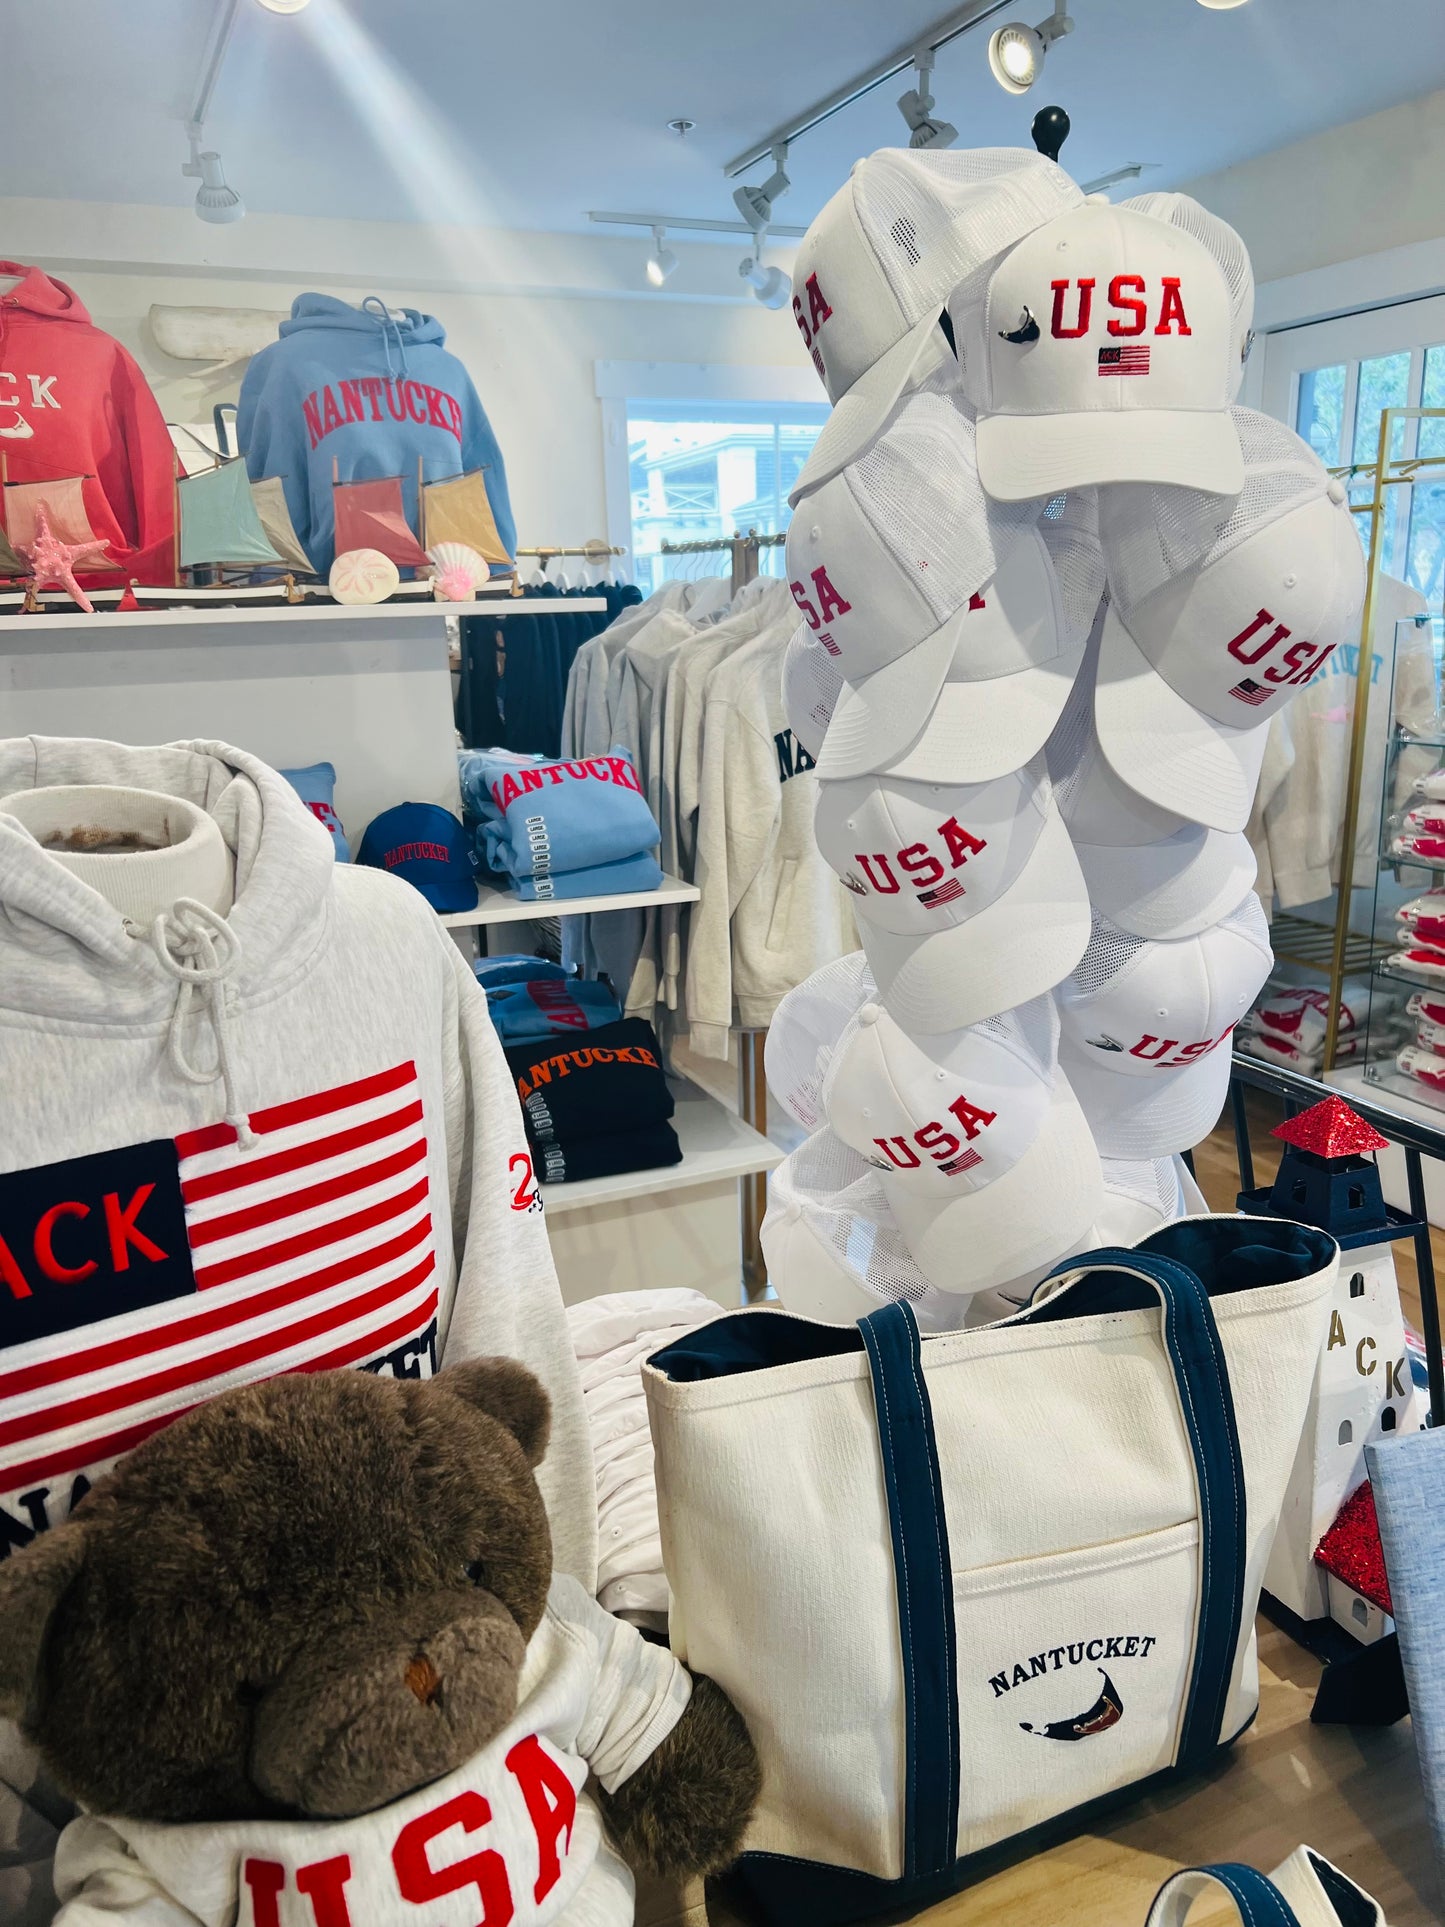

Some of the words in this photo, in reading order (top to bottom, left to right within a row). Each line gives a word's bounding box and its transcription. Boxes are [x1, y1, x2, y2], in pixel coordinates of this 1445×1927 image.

[793, 271, 833, 350] SA
[1051, 274, 1192, 339] USA
[790, 565, 852, 630] SA
[1228, 608, 1337, 684] USA
[855, 816, 987, 894] USA
[518, 1047, 660, 1104] ANTUCKE
[873, 1094, 998, 1168] USA
[988, 1636, 1156, 1698] NANTUCKET
